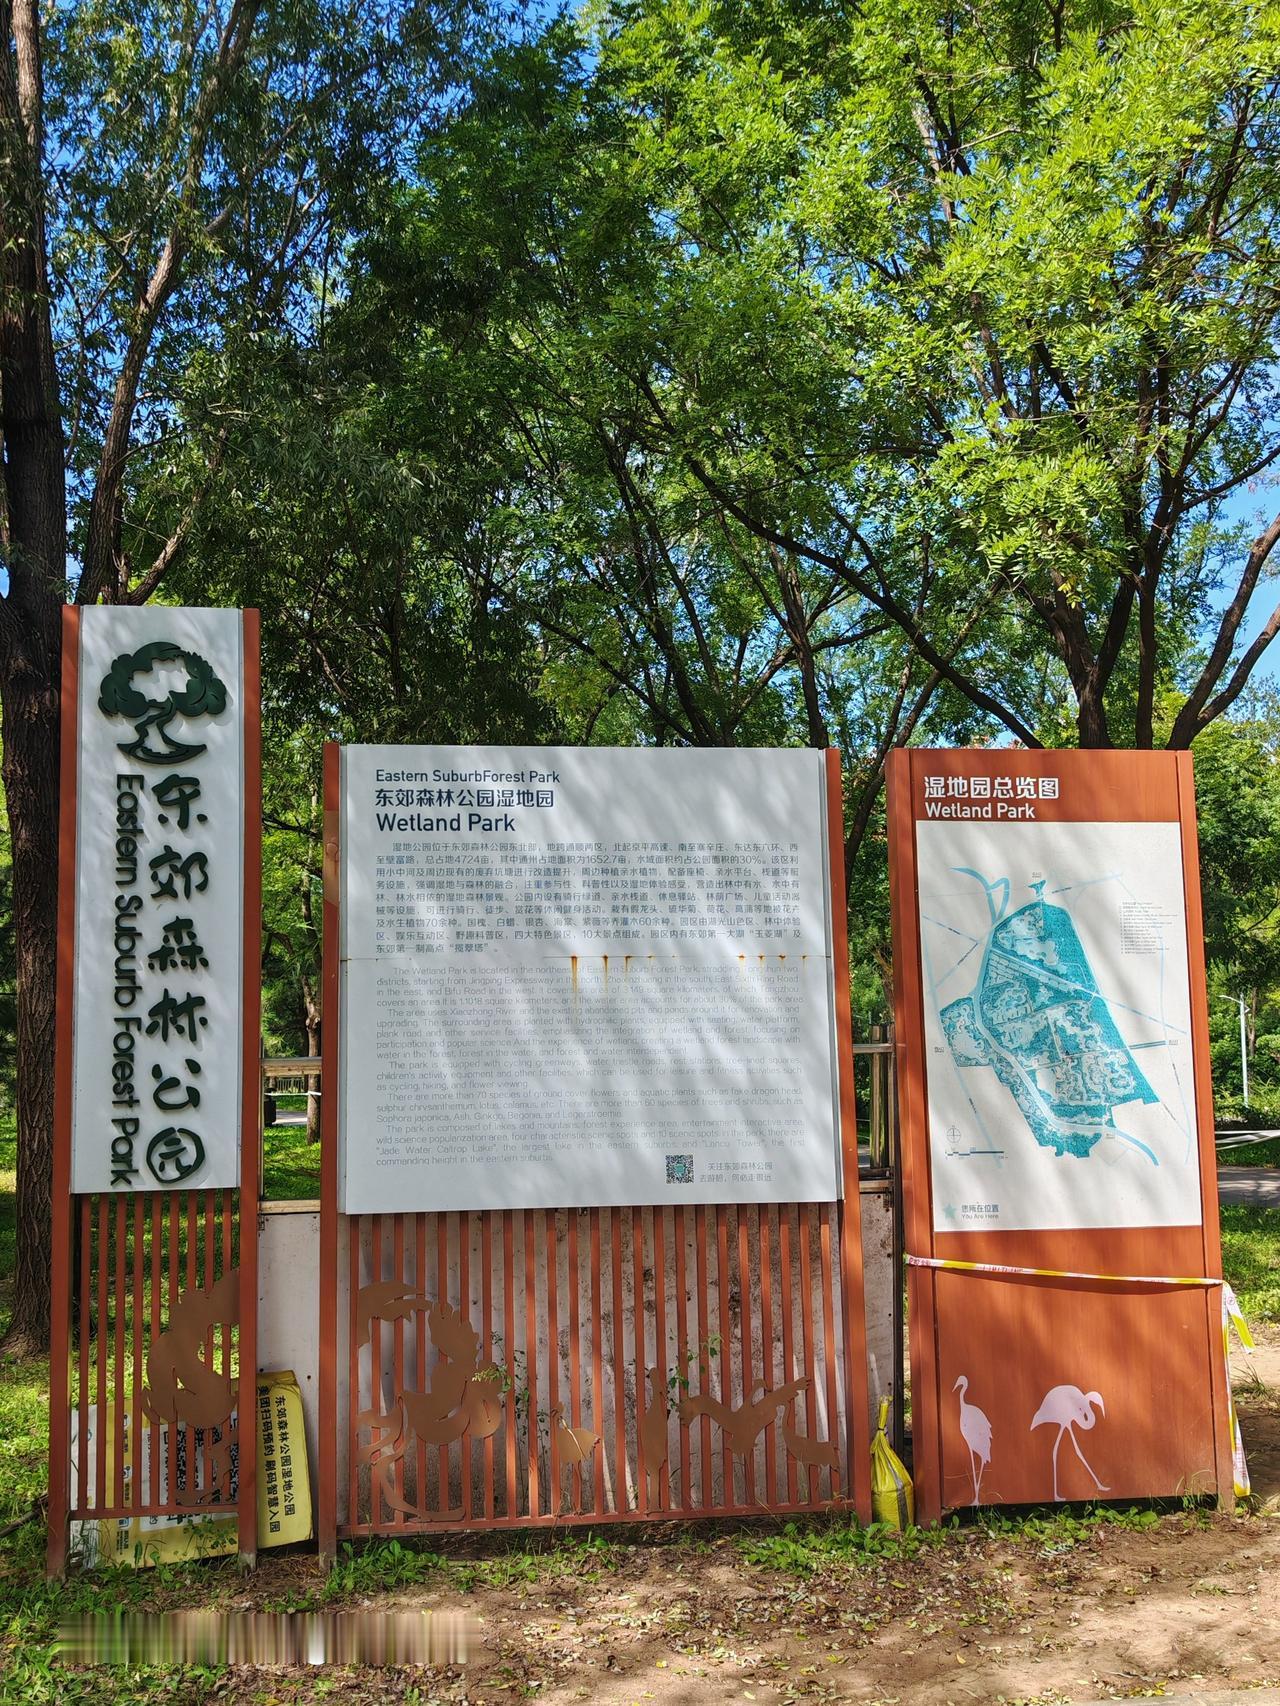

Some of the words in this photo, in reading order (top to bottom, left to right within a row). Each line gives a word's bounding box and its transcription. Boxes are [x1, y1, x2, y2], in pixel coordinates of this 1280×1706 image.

[376, 769, 428, 782] Eastern
[529, 770, 560, 783] Park
[924, 776, 1060, 800] 湿地园总览图
[375, 788, 554, 808] 东郊森林公园湿地园
[925, 802, 992, 819] Wetland
[997, 803, 1036, 819] Park
[115, 774, 144, 886] Eastern
[376, 813, 461, 832] Wetland
[468, 813, 516, 832] Park
[113, 894, 143, 1008] Suburb
[412, 966, 446, 974] Wetland
[478, 965, 508, 973] located
[145, 773, 209, 1184] 东郊森林公园
[446, 976, 466, 984] from
[442, 1018, 490, 1028] surrounding
[376, 1030, 398, 1039] plank
[376, 1040, 428, 1049] participation
[111, 1017, 142, 1108] Forest
[376, 1051, 400, 1059] water
[408, 1061, 428, 1070] park
[388, 1093, 412, 1101] There
[394, 1135, 428, 1143] science
[110, 1118, 139, 1186] Park
[376, 1156, 430, 1166] commanding
[274, 1395, 296, 1516] 东郊森林公园湿地公园
[264, 1459, 281, 1533] 刷码智慧入园
